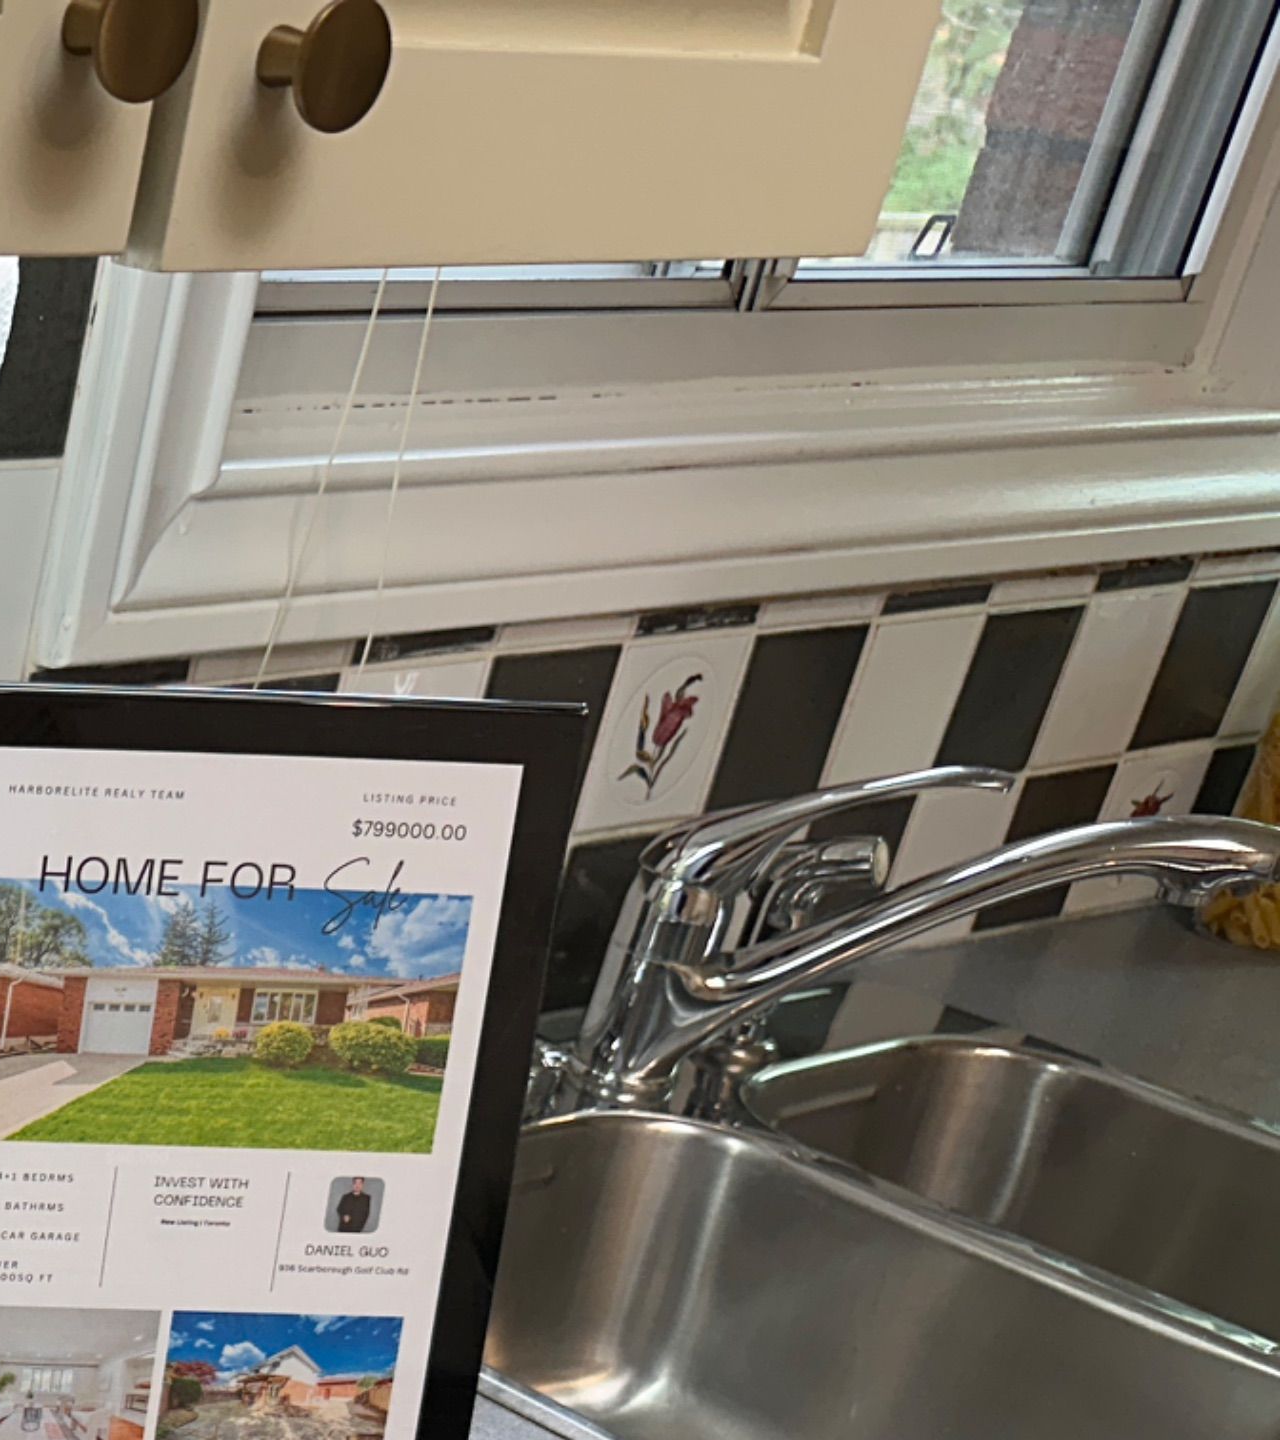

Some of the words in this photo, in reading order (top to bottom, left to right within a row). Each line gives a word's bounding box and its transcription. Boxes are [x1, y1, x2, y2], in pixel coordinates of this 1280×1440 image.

[8, 783, 100, 800] HARBORELITE
[104, 785, 149, 800] REALY
[151, 788, 186, 801] TEAM
[362, 793, 415, 806] LISTING
[419, 794, 458, 807] PRICE
[351, 817, 467, 842] $799000.00
[38, 854, 183, 898] HOME
[200, 859, 297, 902] FOR
[322, 856, 410, 935] Sale
[22, 1171, 76, 1184] BEDRMS
[154, 1175, 206, 1190] INVEST
[209, 1176, 250, 1191] WITH
[4, 1201, 65, 1213] BATHRMS
[153, 1193, 245, 1209] CONFIDENCE
[0, 1231, 26, 1242] CAR
[29, 1231, 82, 1243] GARAGE
[304, 1243, 356, 1259] DANIEL
[358, 1245, 390, 1260] GUO
[297, 1264, 354, 1276] Scarborough
[354, 1266, 375, 1276] Golf
[375, 1266, 396, 1277] Club
